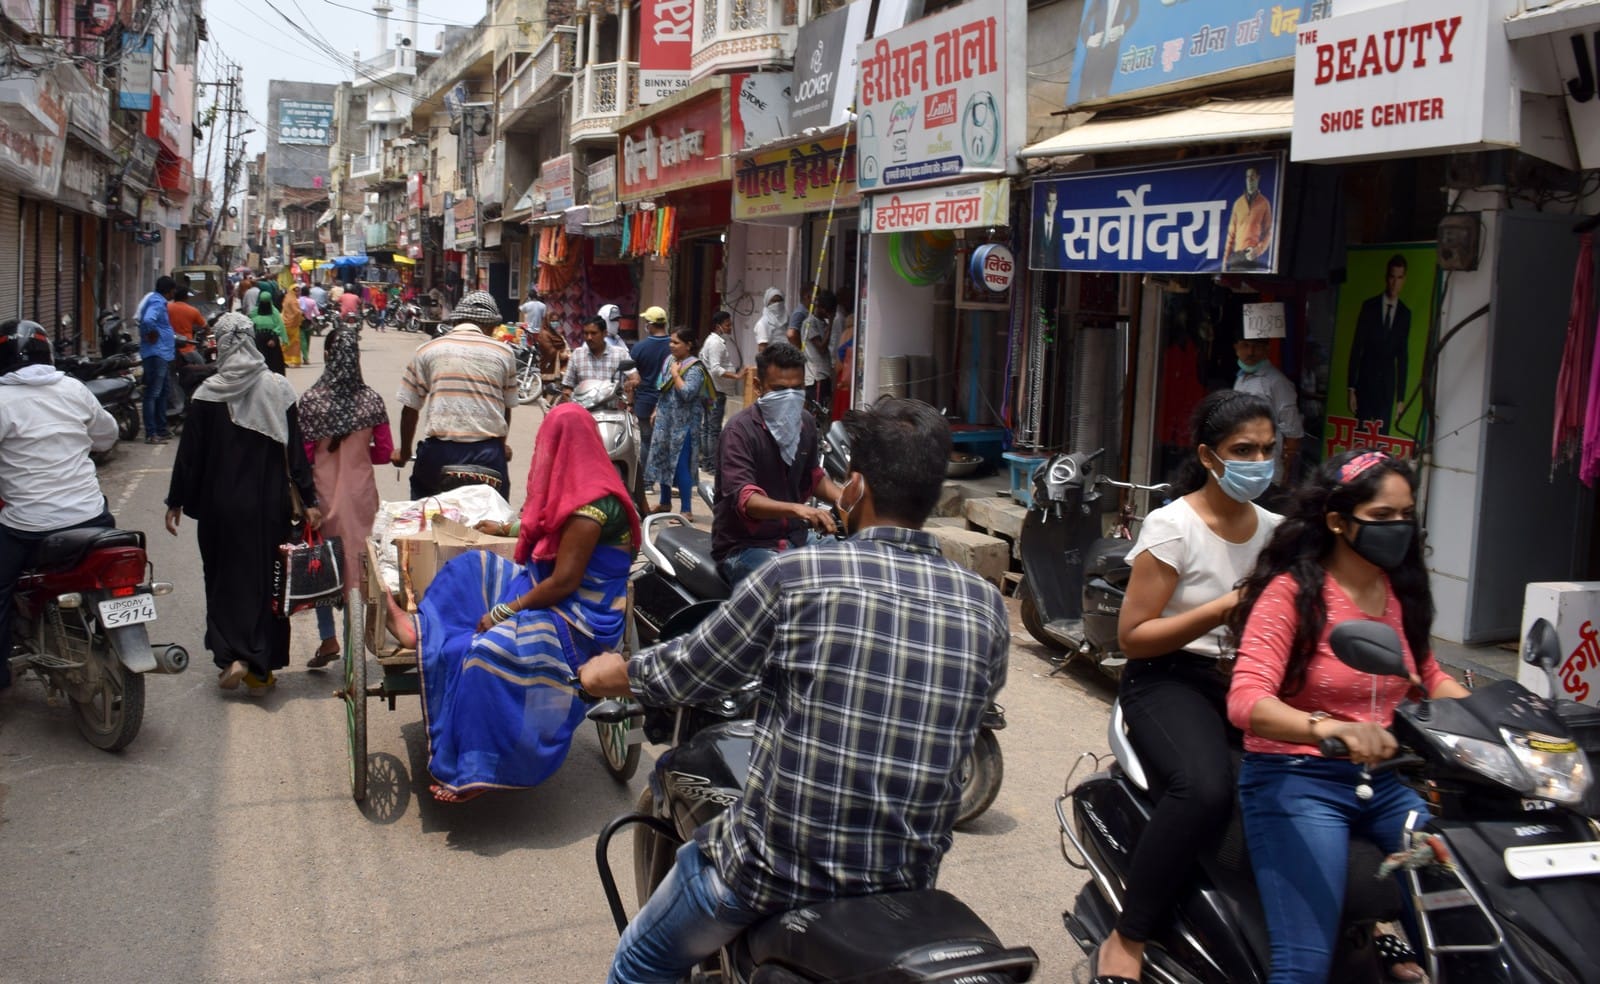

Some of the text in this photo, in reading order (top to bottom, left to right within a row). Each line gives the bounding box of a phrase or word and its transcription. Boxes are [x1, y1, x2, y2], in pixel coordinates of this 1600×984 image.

[1298, 29, 1318, 46] THE
[1314, 15, 1463, 86] BEAUTY
[861, 16, 998, 106] हरीसन ताला
[1567, 30, 1600, 104] J
[644, 79, 673, 87] BINNY
[794, 72, 833, 103] JOCKEY
[1320, 97, 1444, 134] SHOE CENTER
[736, 157, 788, 199] गौरव
[875, 195, 931, 231] हरीसन
[935, 196, 982, 224] ताला
[1062, 183, 1228, 261] सर्वोदय
[984, 254, 1012, 273] लिंक
[107, 606, 154, 626] 5914
